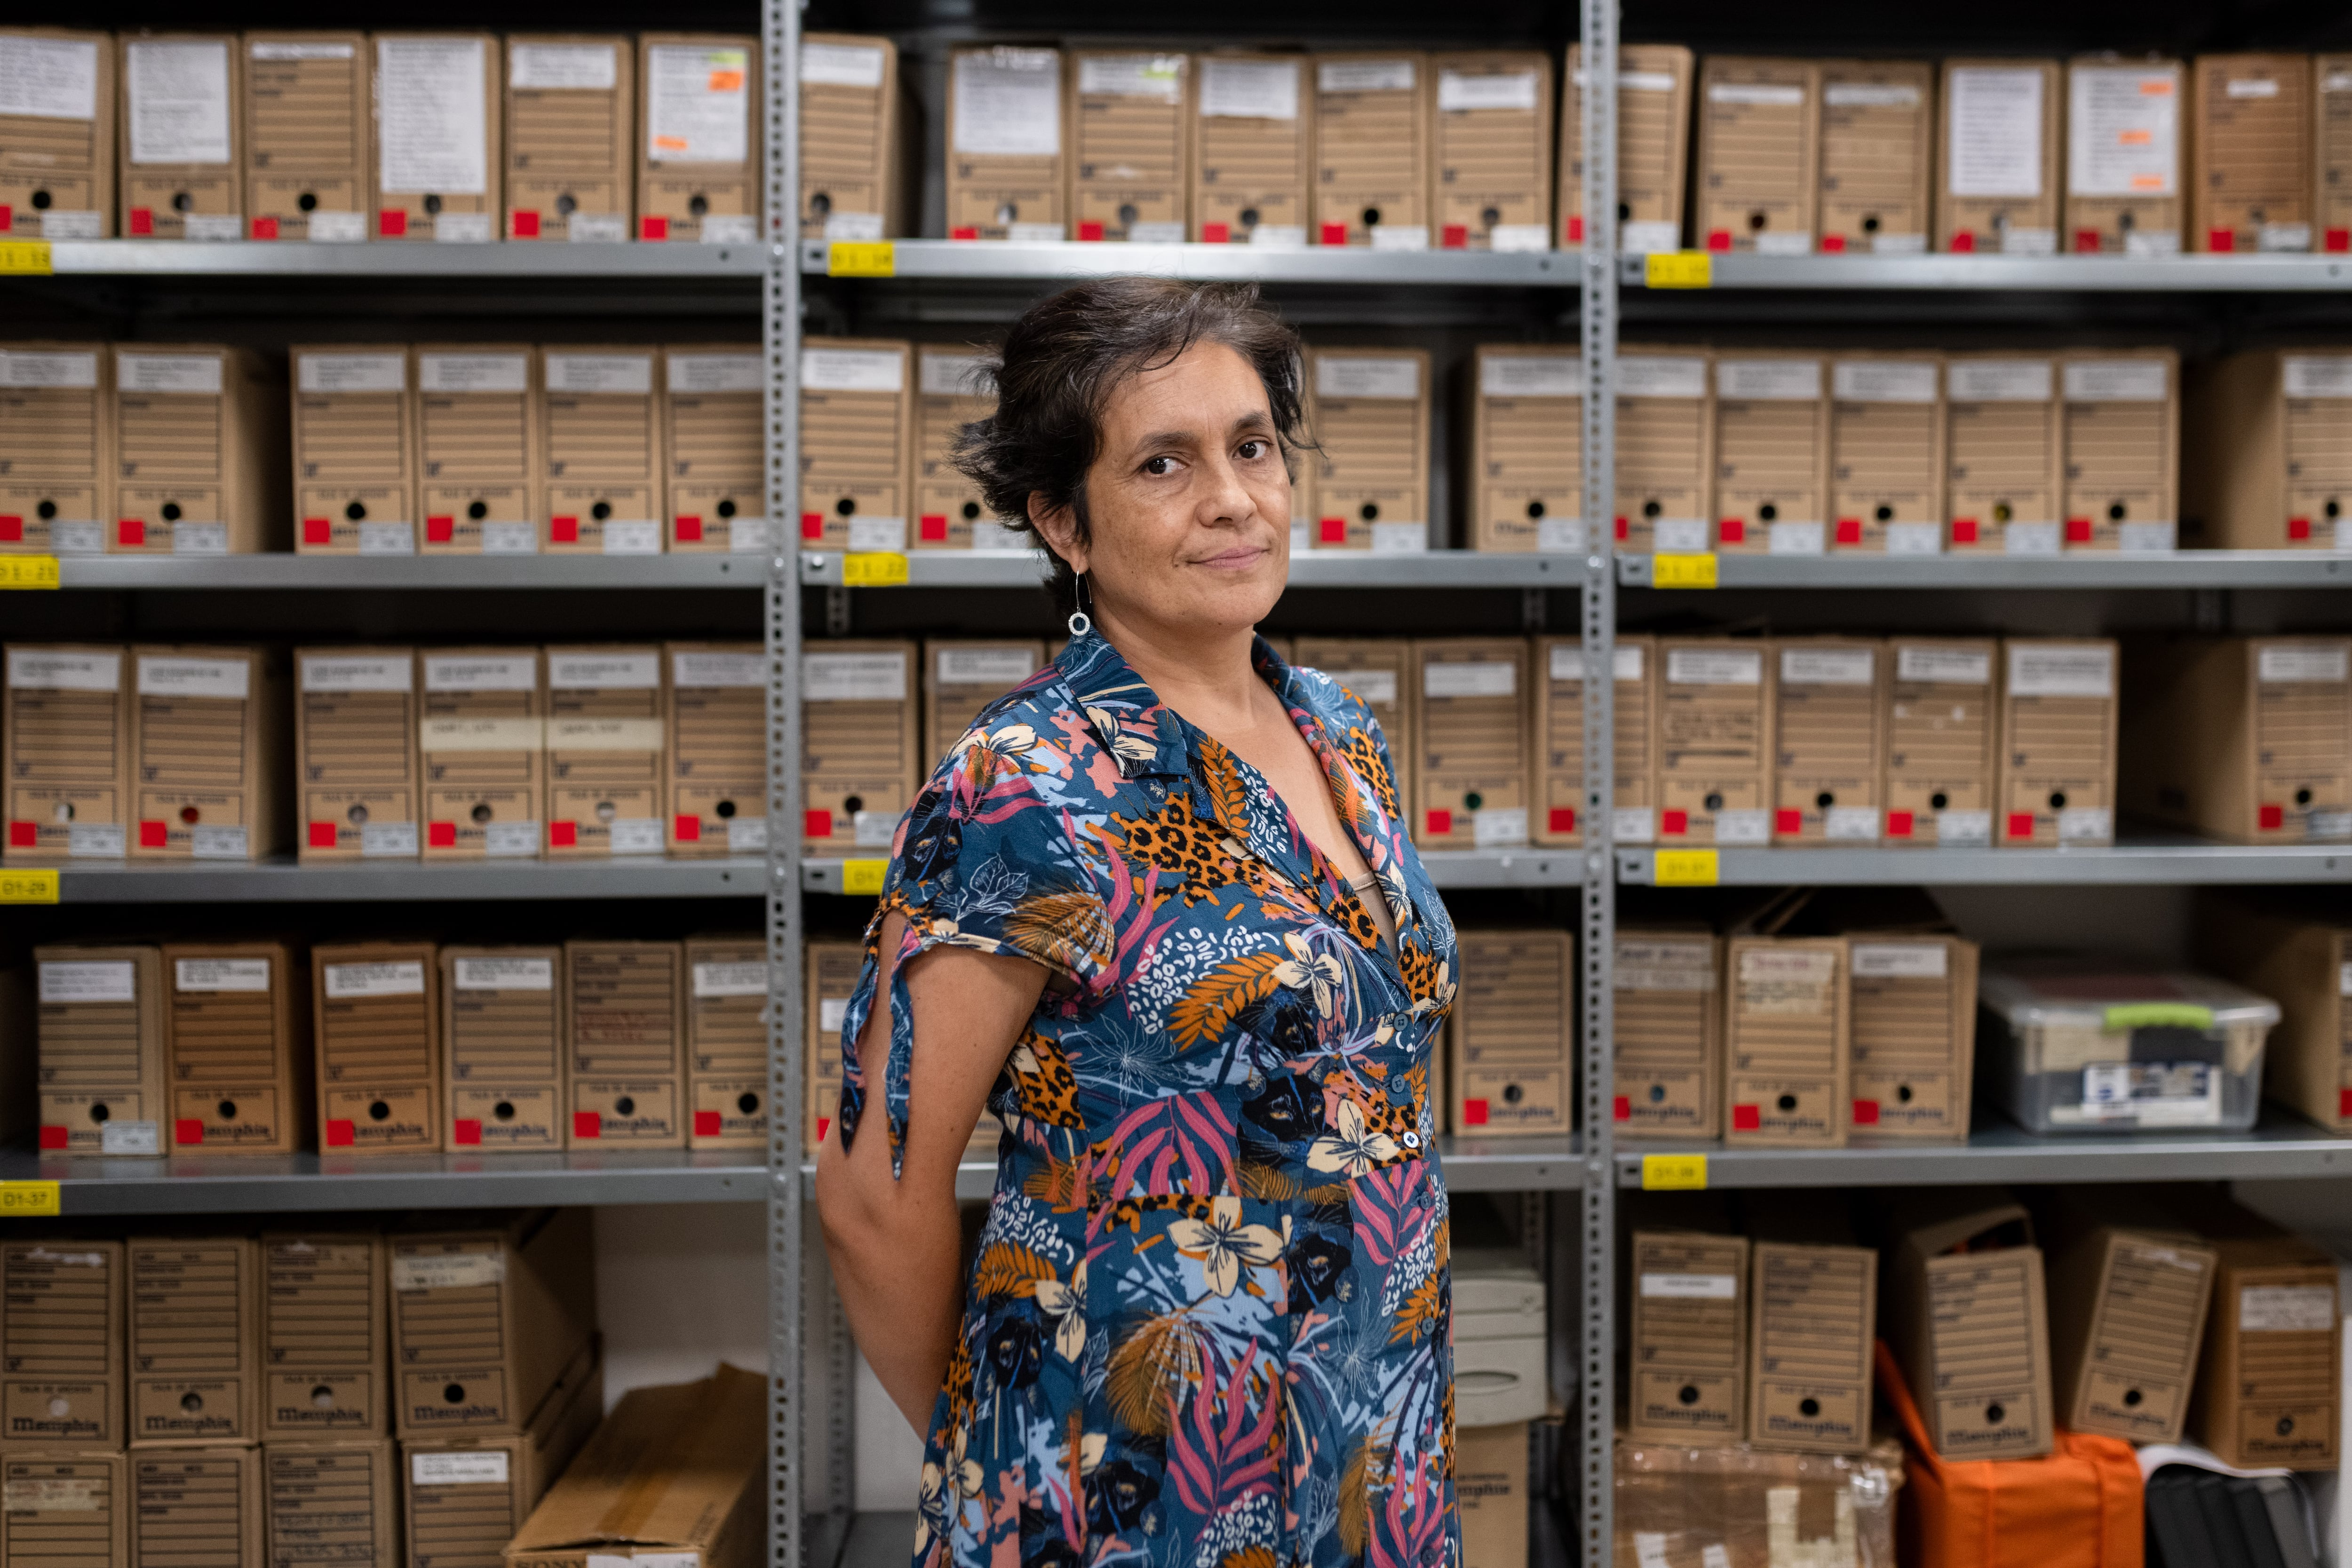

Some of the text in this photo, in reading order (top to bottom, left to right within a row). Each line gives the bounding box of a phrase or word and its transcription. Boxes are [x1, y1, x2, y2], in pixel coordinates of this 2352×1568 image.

[203, 1123, 269, 1142] emphis
[354, 1123, 423, 1142] emphis
[482, 1124, 548, 1142] emphis
[601, 1117, 667, 1135] emphis
[278, 1407, 363, 1426] Memphis
[414, 1405, 498, 1422] Memphis
[13, 1417, 99, 1436] Memphis
[146, 1416, 232, 1435] Memphis
